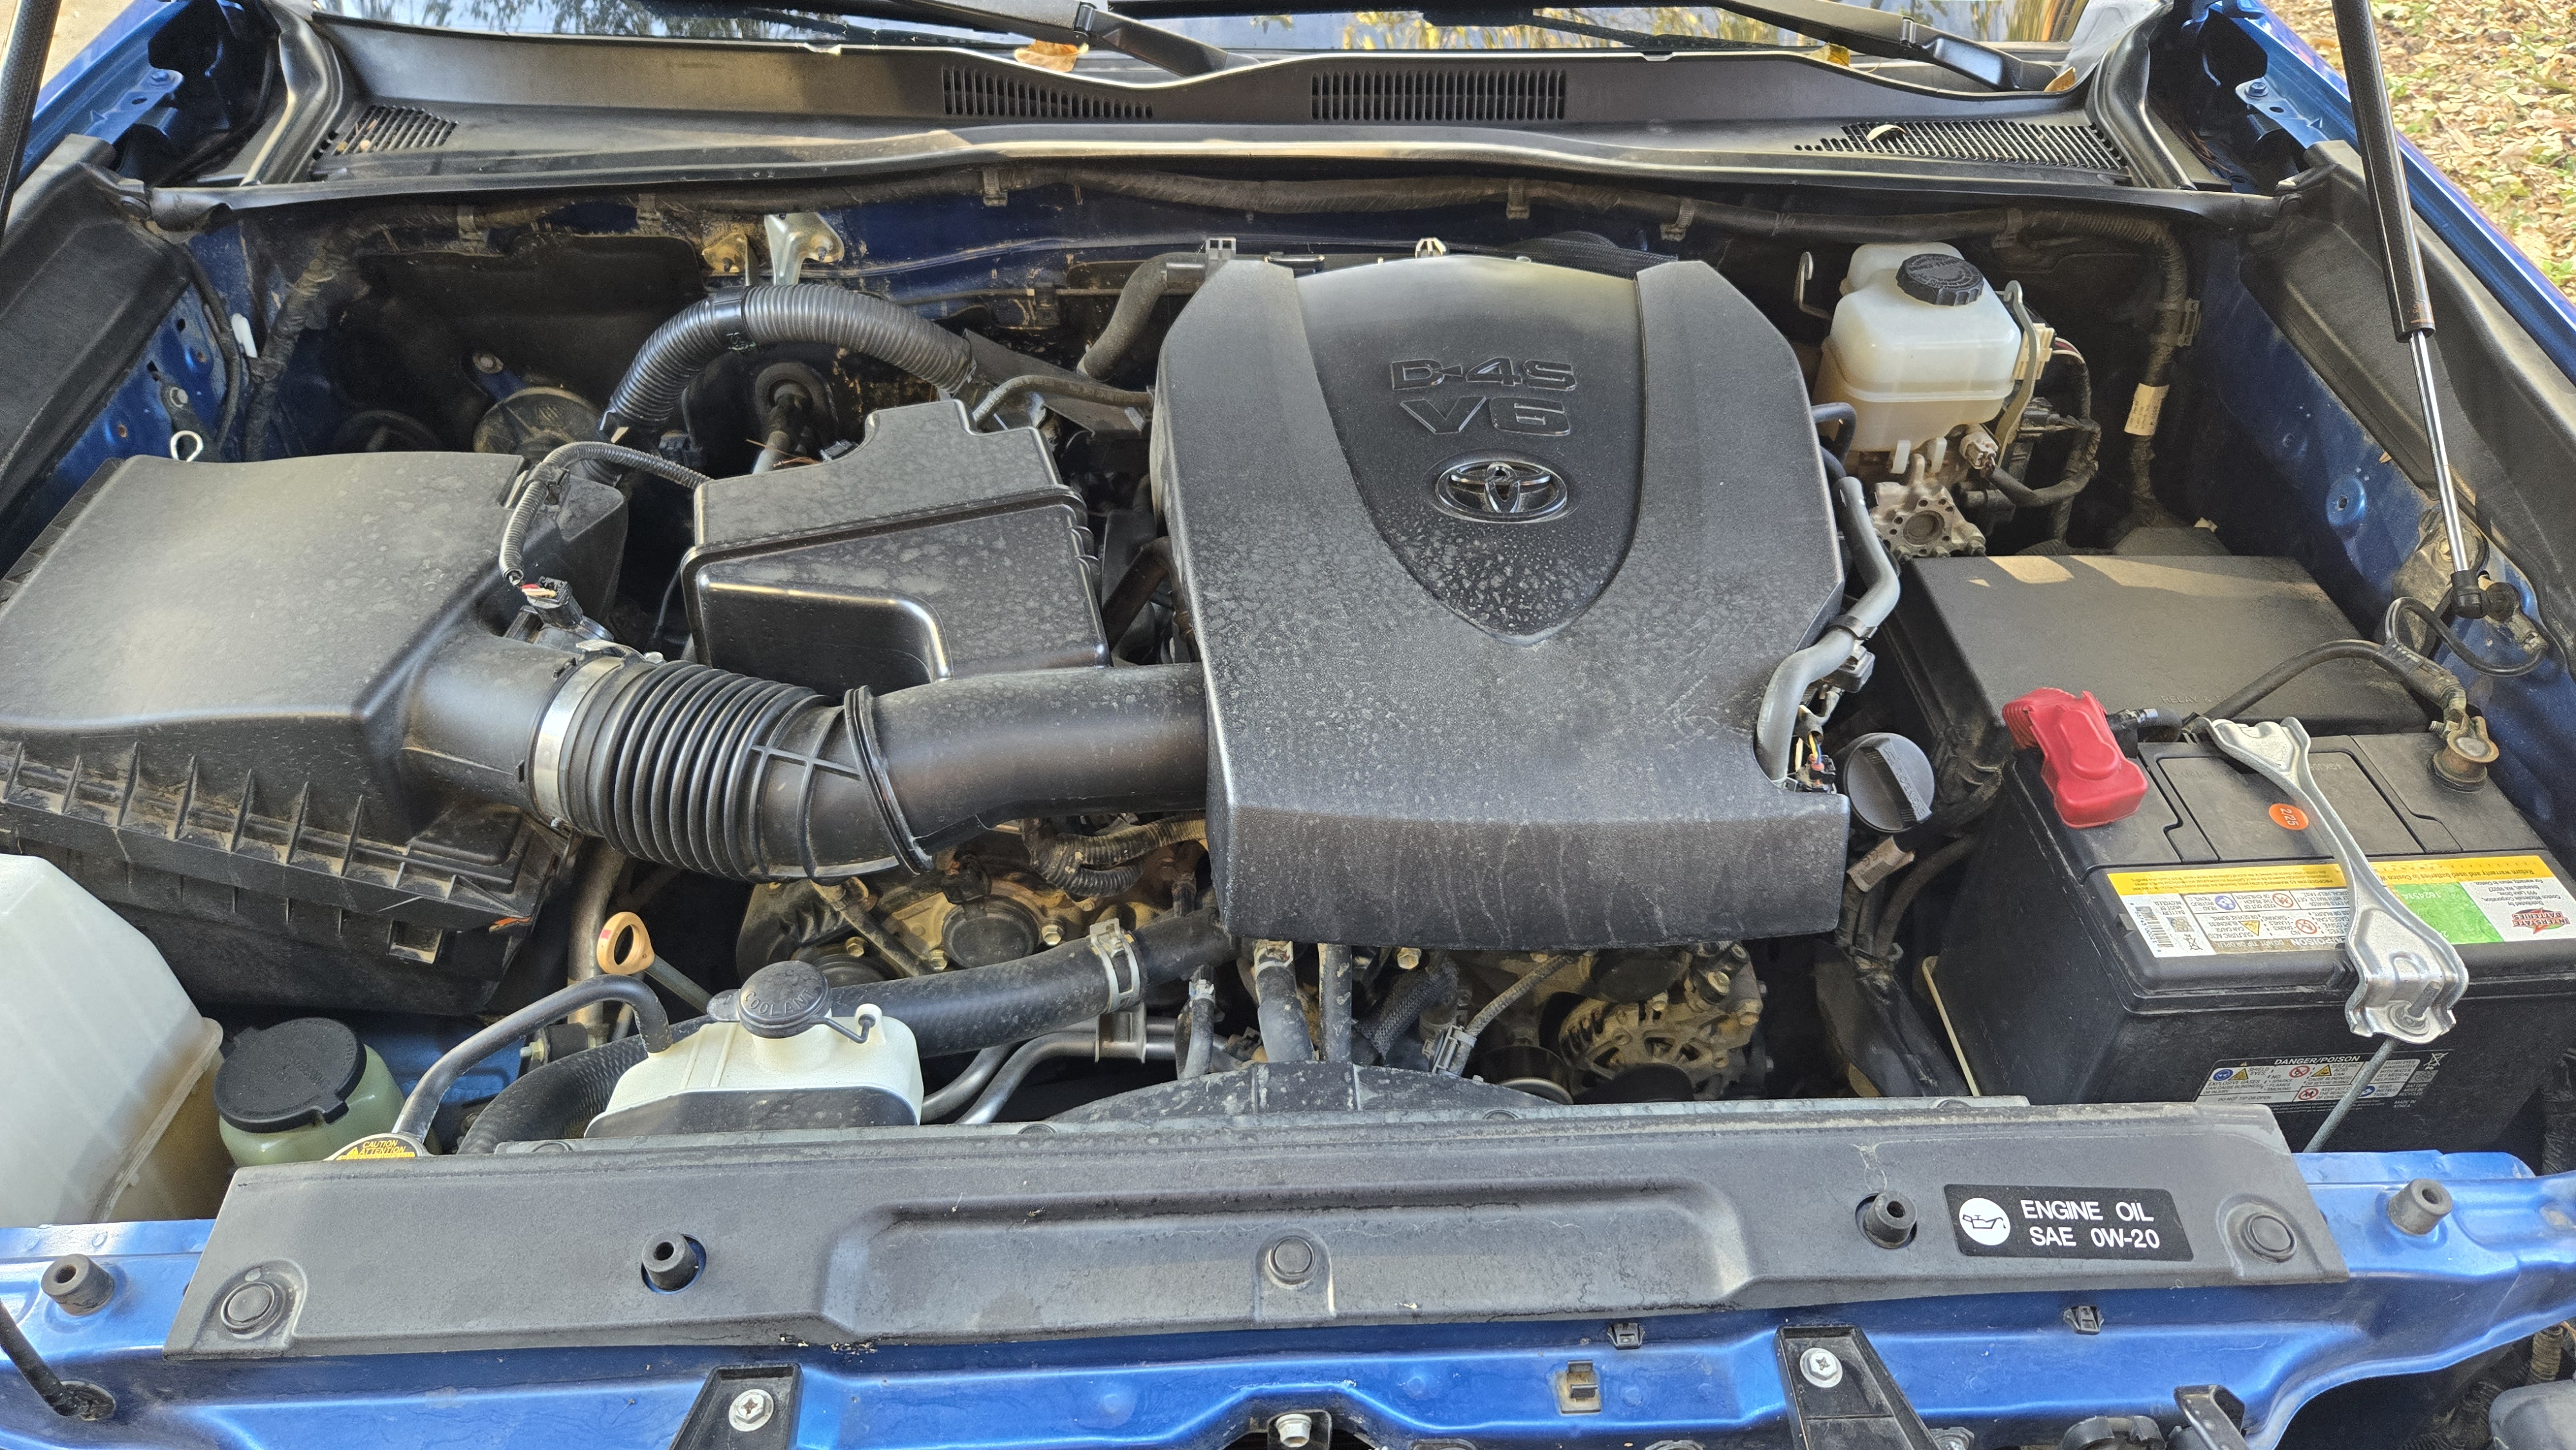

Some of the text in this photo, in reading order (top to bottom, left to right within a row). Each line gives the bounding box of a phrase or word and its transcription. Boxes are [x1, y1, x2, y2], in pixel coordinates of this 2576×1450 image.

[1390, 357, 1577, 391] D-4S
[1399, 395, 1571, 437] V6
[1904, 783, 1926, 817] ENGINE
[2280, 807, 2299, 827] 2/25
[744, 987, 815, 1017] COOLANT
[2274, 1055, 2360, 1066] DANGER/POISON
[359, 1145, 406, 1154] ATTENTION
[363, 1140, 398, 1148] CAUTION
[2020, 1200, 2154, 1222] ENGINE OIL
[2029, 1226, 2160, 1249] SAE 0W-20
